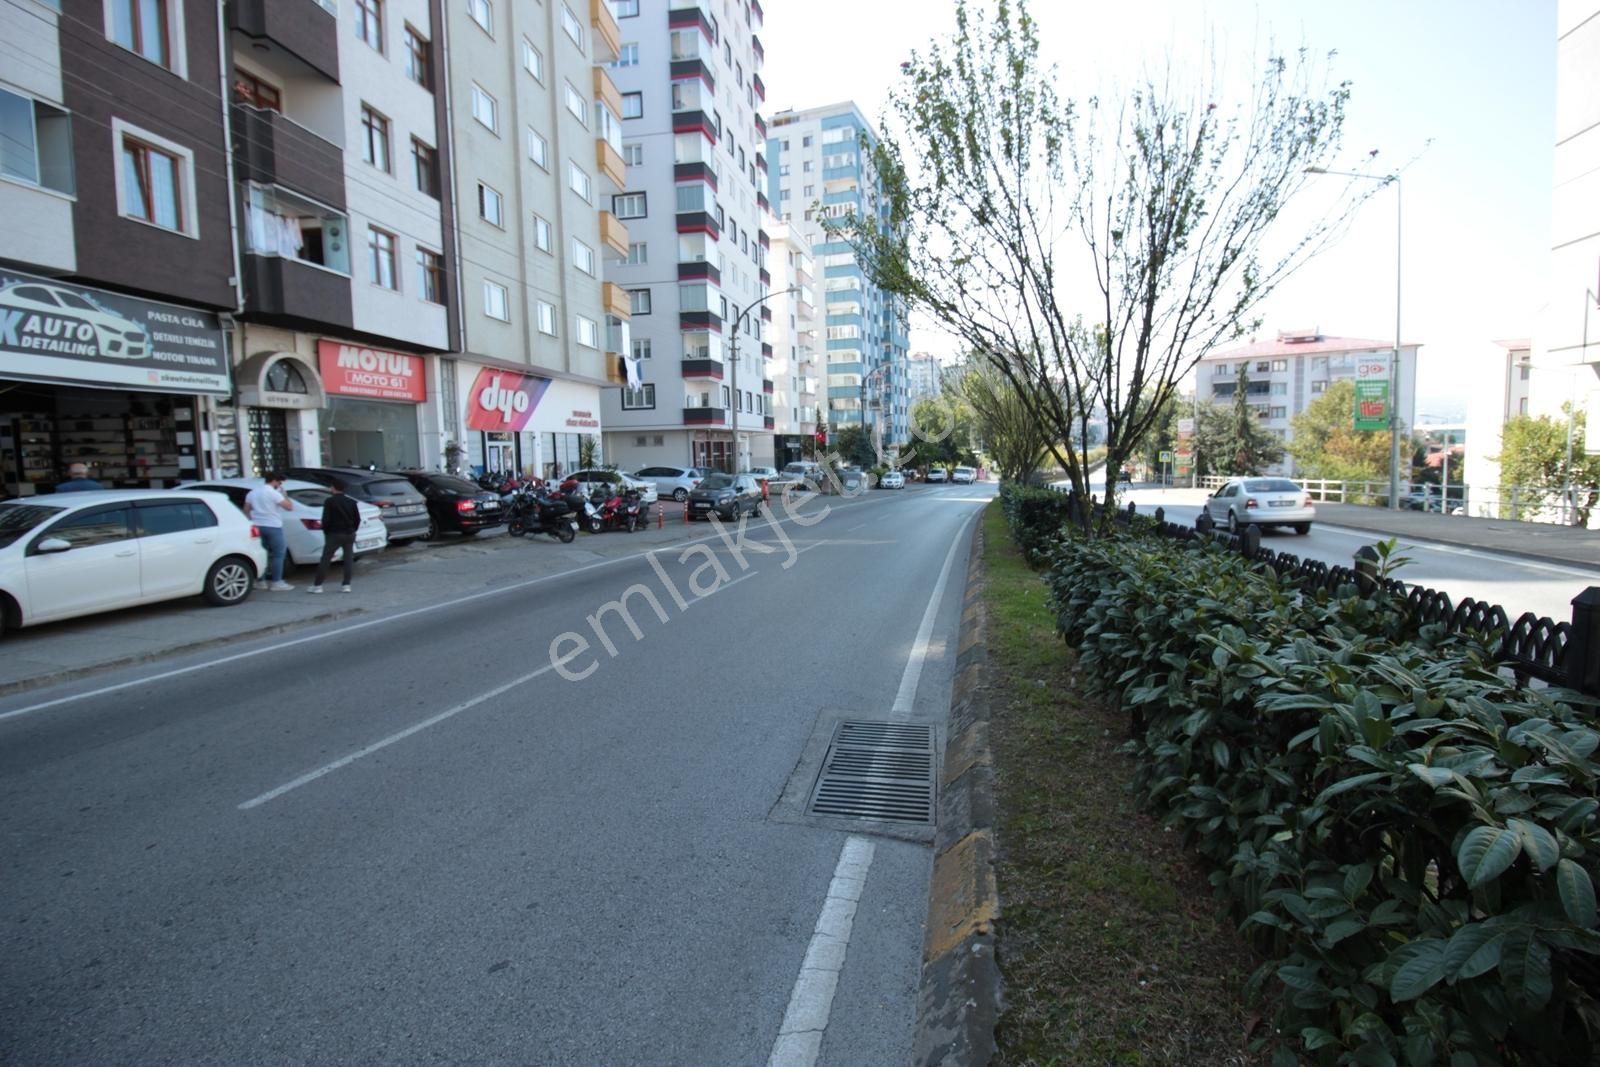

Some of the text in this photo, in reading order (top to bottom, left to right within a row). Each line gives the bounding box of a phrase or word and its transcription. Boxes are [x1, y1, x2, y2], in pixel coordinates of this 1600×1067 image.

[23, 315, 94, 341] AUTO
[147, 311, 179, 325] PASTA
[20, 335, 97, 357] DETAILING
[152, 351, 185, 363] MOTOR
[337, 345, 413, 377] MOTUL
[351, 372, 403, 388] MOTO 61
[480, 375, 529, 423] dyo
